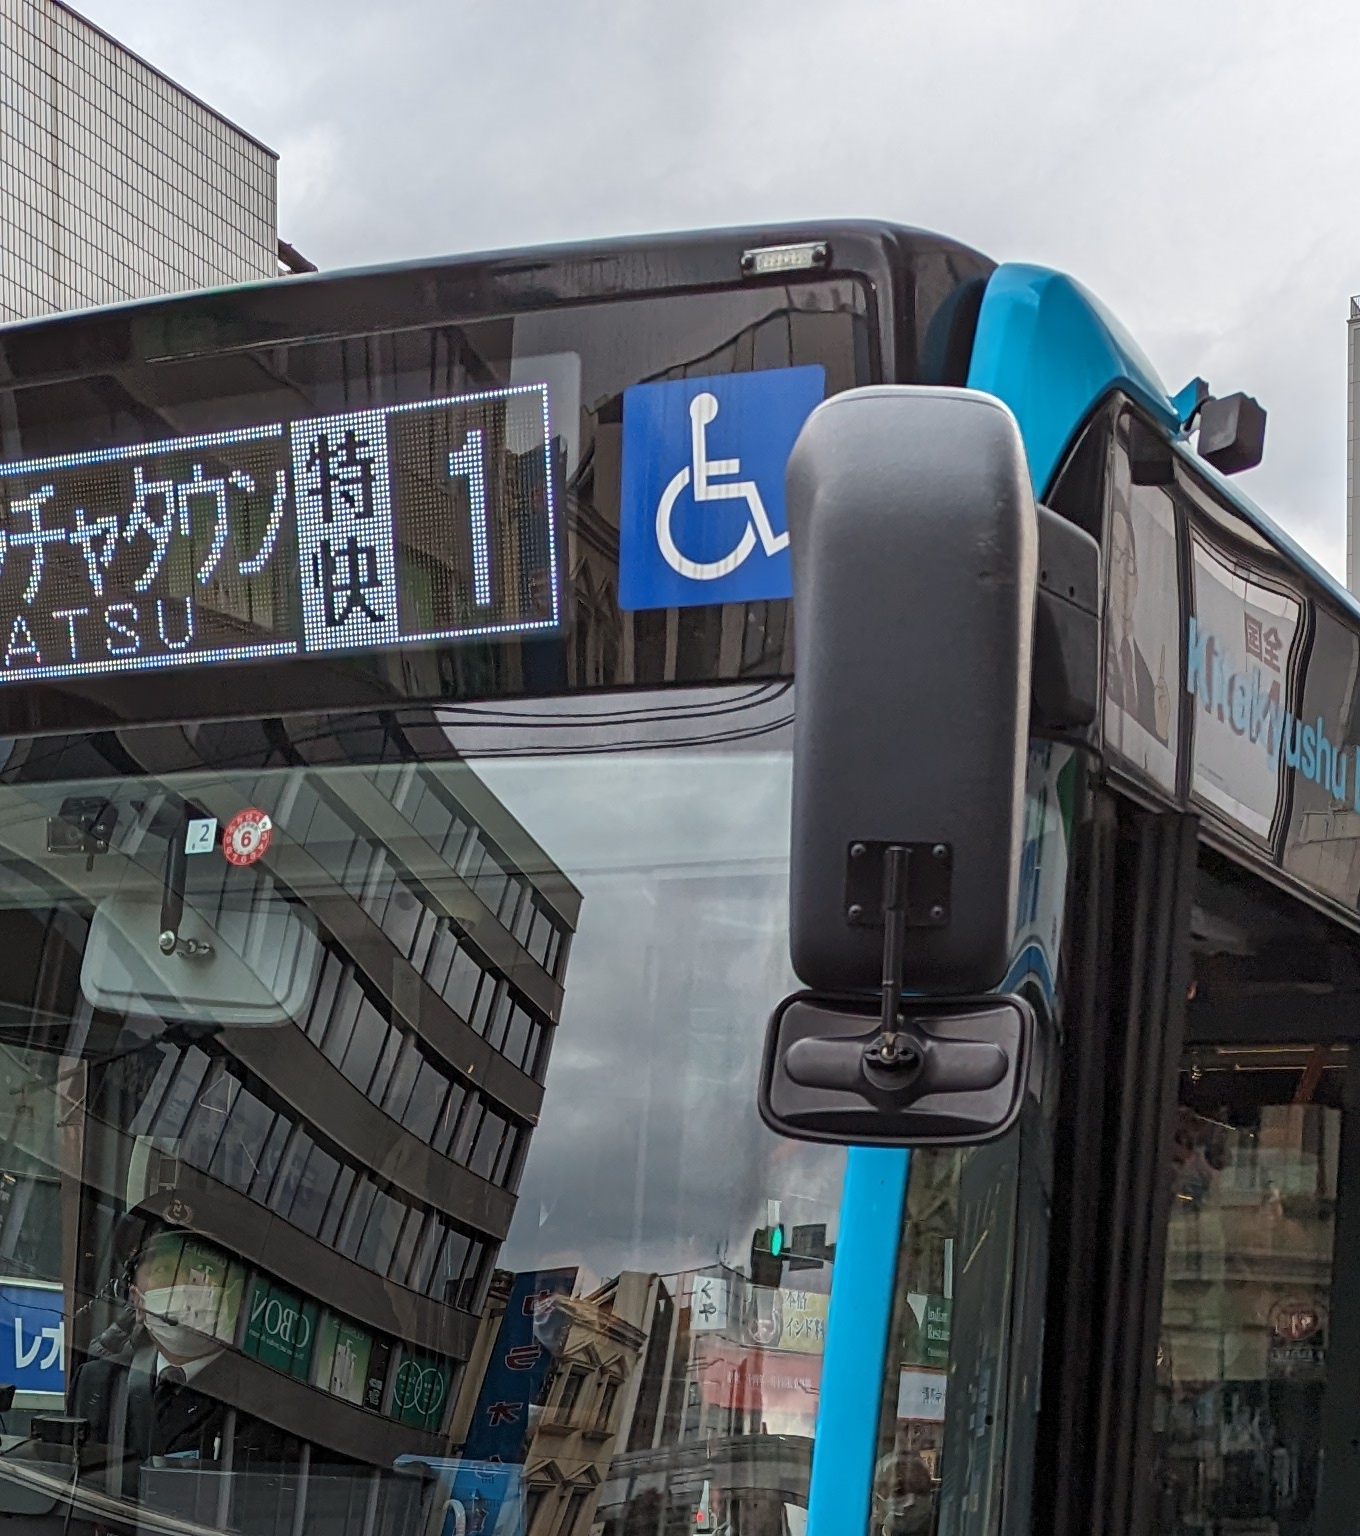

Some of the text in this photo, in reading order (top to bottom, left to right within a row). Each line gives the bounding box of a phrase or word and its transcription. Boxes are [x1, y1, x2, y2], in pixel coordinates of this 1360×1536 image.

[303, 428, 386, 629] 特快
[448, 429, 492, 606] 1
[199, 823, 210, 842] 2
[240, 831, 252, 848] 6
